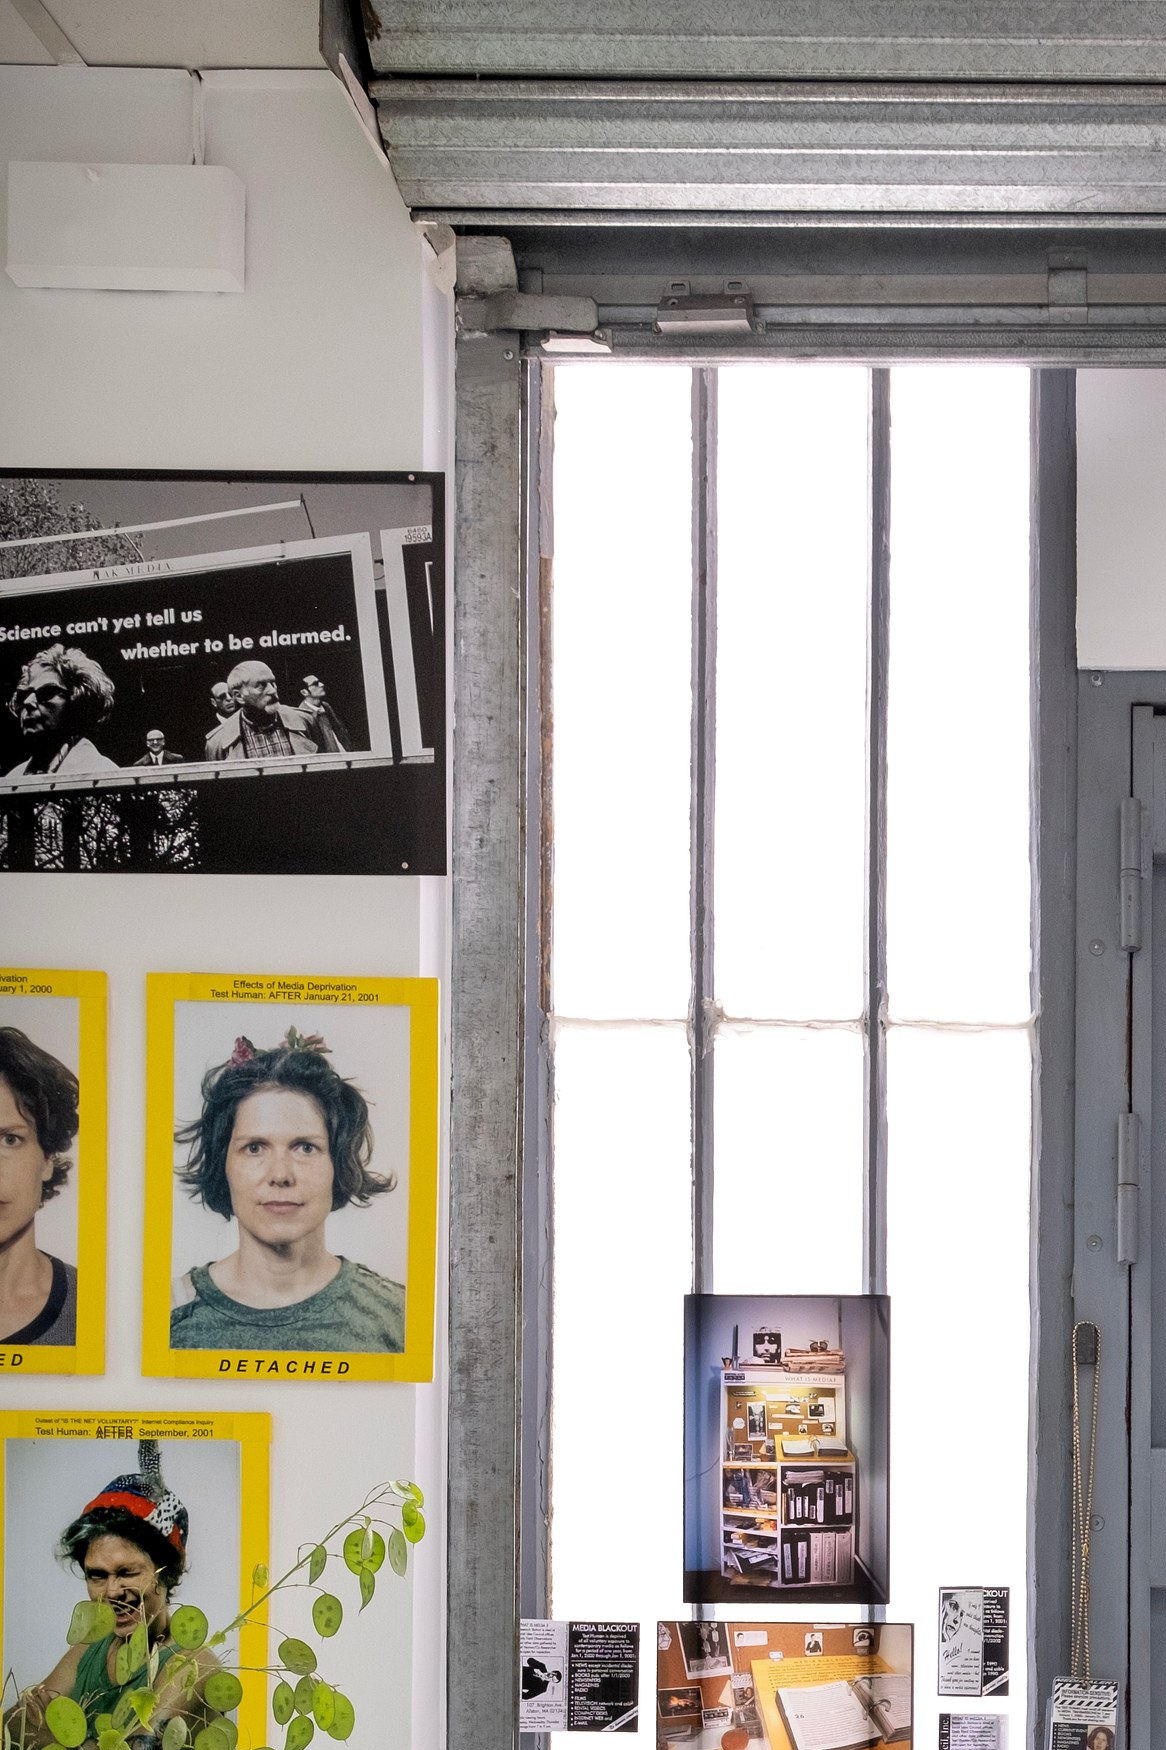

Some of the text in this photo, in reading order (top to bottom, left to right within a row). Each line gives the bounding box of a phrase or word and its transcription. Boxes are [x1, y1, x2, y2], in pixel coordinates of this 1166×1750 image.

[66, 616, 109, 635] can't
[112, 613, 142, 634] yet
[146, 608, 175, 627] tell
[181, 609, 203, 623] us
[120, 624, 352, 660] whether to be alarmed.
[20, 985, 28, 994] 1,
[30, 985, 53, 994] 2000
[233, 980, 357, 992] Effects of Media Deprivation
[210, 990, 379, 1003] Test Human: AFTER January 21, 2001
[218, 1358, 350, 1375] DETACHED
[36, 1427, 54, 1436] Test
[56, 1427, 91, 1436] Human:
[138, 1428, 190, 1438] September,
[192, 1428, 214, 1437] 2001
[572, 1624, 638, 1633] MEDIA BLACKOUT
[940, 1716, 949, 1734] Inc.
